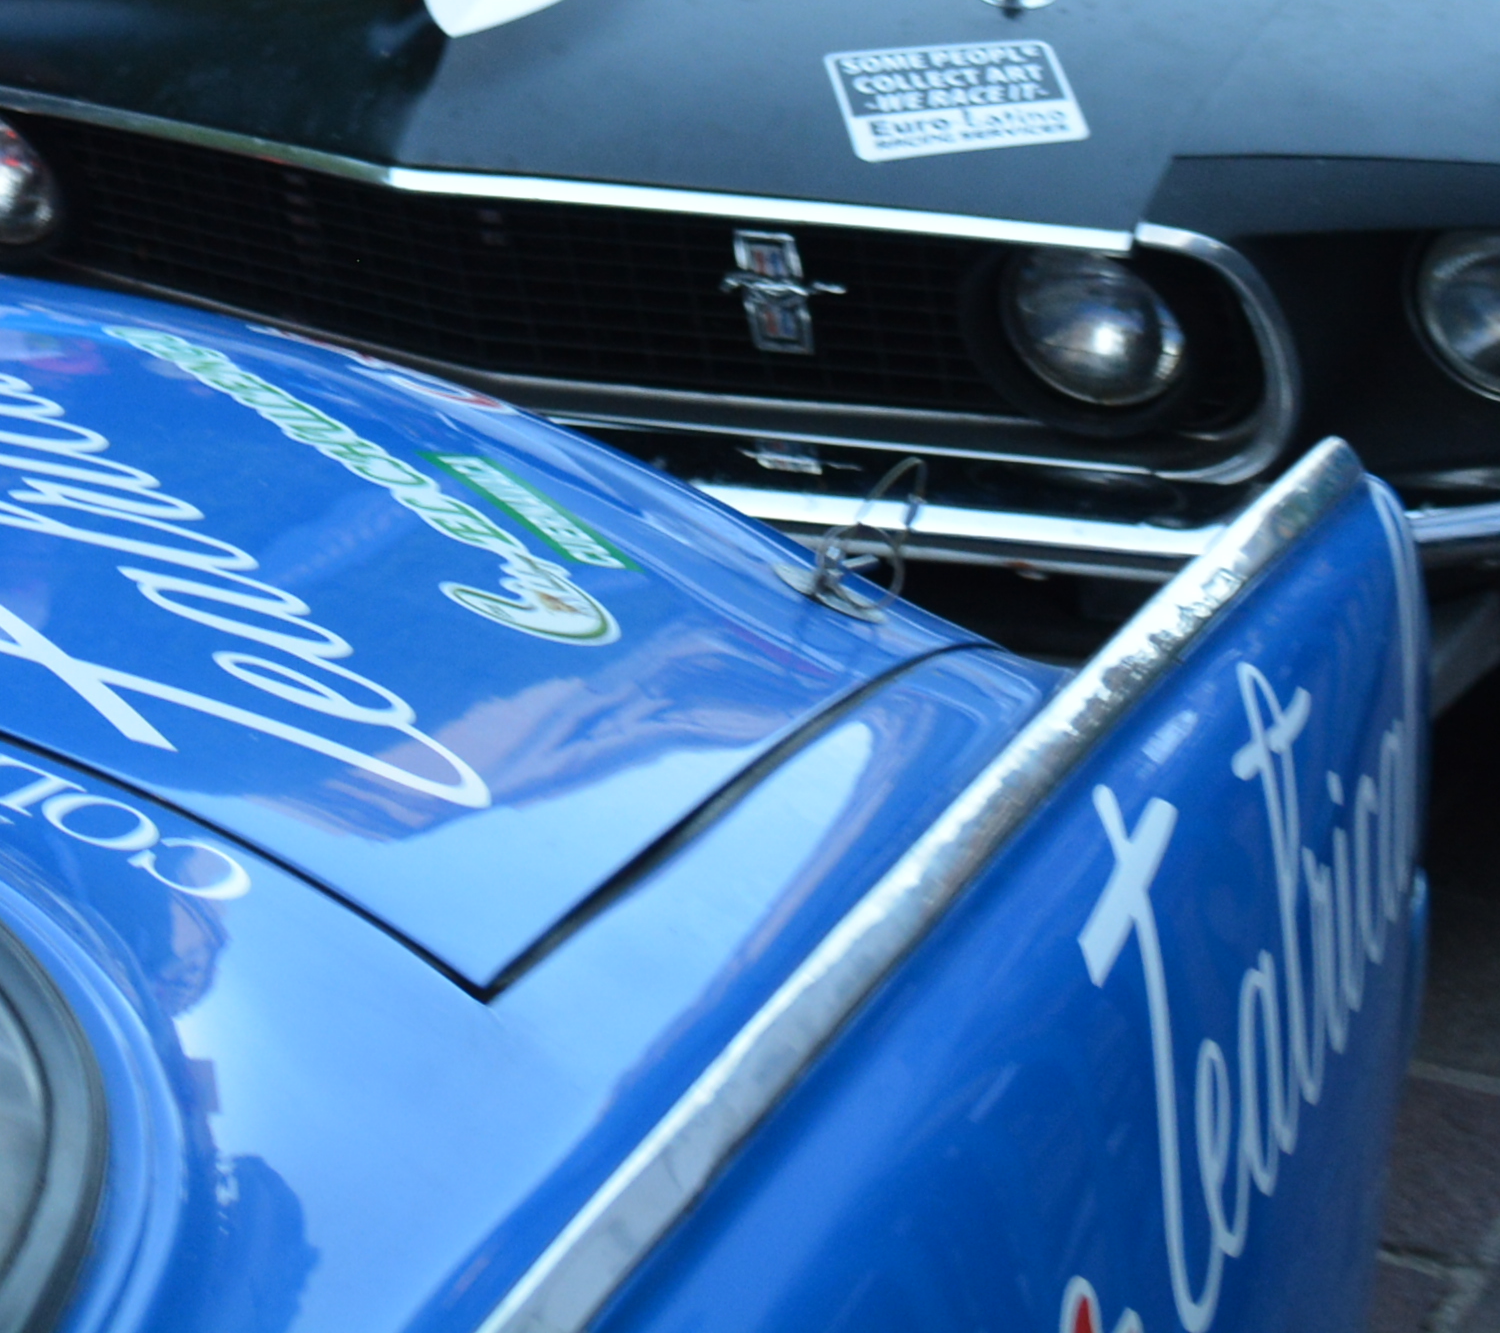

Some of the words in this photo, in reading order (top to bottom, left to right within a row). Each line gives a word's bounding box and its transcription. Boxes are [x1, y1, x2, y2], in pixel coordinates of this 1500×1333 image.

[839, 51, 927, 76] SOME
[928, 45, 1042, 69] PEOPLE
[852, 68, 982, 96] COLLECT
[985, 63, 1044, 85] ART
[926, 86, 1006, 109] RACE
[867, 117, 950, 138] Euro
[960, 107, 1068, 129] Latino
